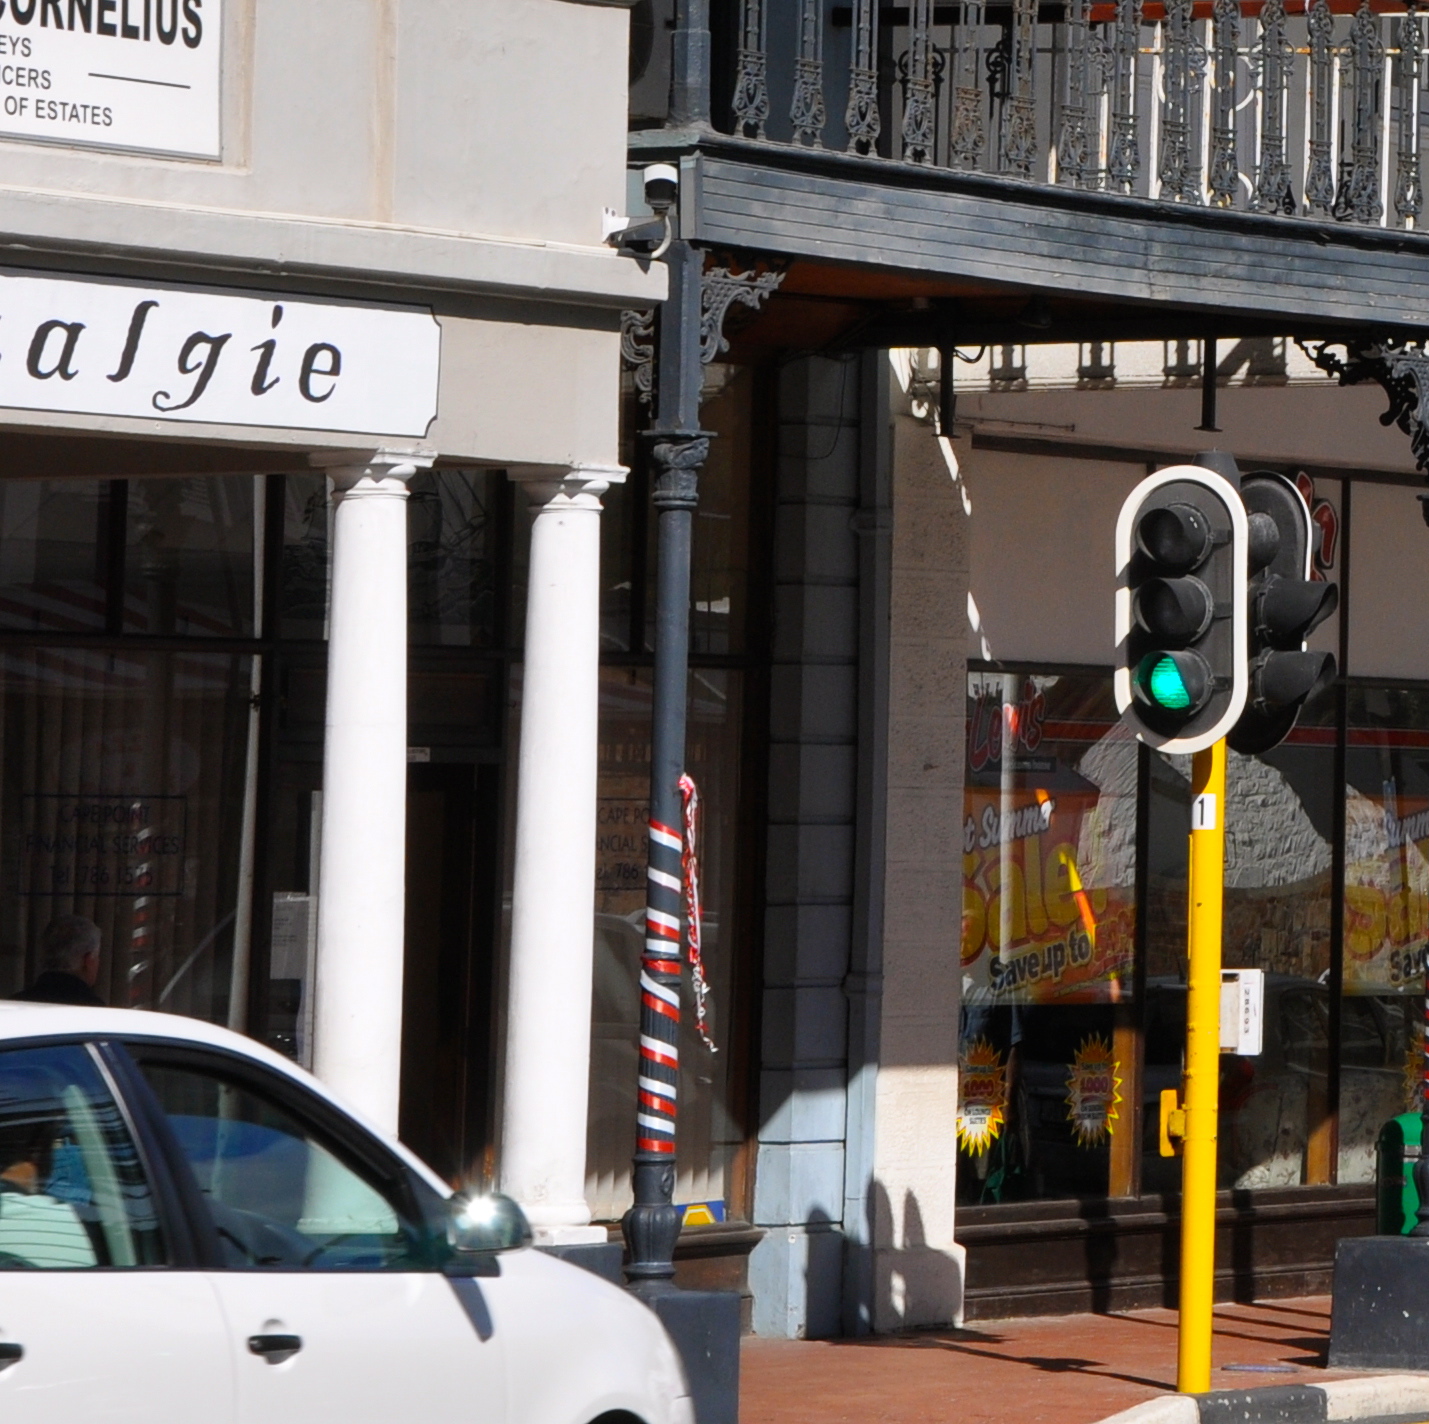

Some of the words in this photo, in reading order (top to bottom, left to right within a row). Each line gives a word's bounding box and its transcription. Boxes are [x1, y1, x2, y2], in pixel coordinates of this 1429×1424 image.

[4, 95, 29, 116] OF
[35, 98, 113, 127] ESTATES
[0, 300, 342, 412] algie
[1197, 796, 1205, 826] 1
[989, 953, 1041, 994] Save
[1041, 942, 1067, 980] up
[1068, 931, 1092, 964] to
